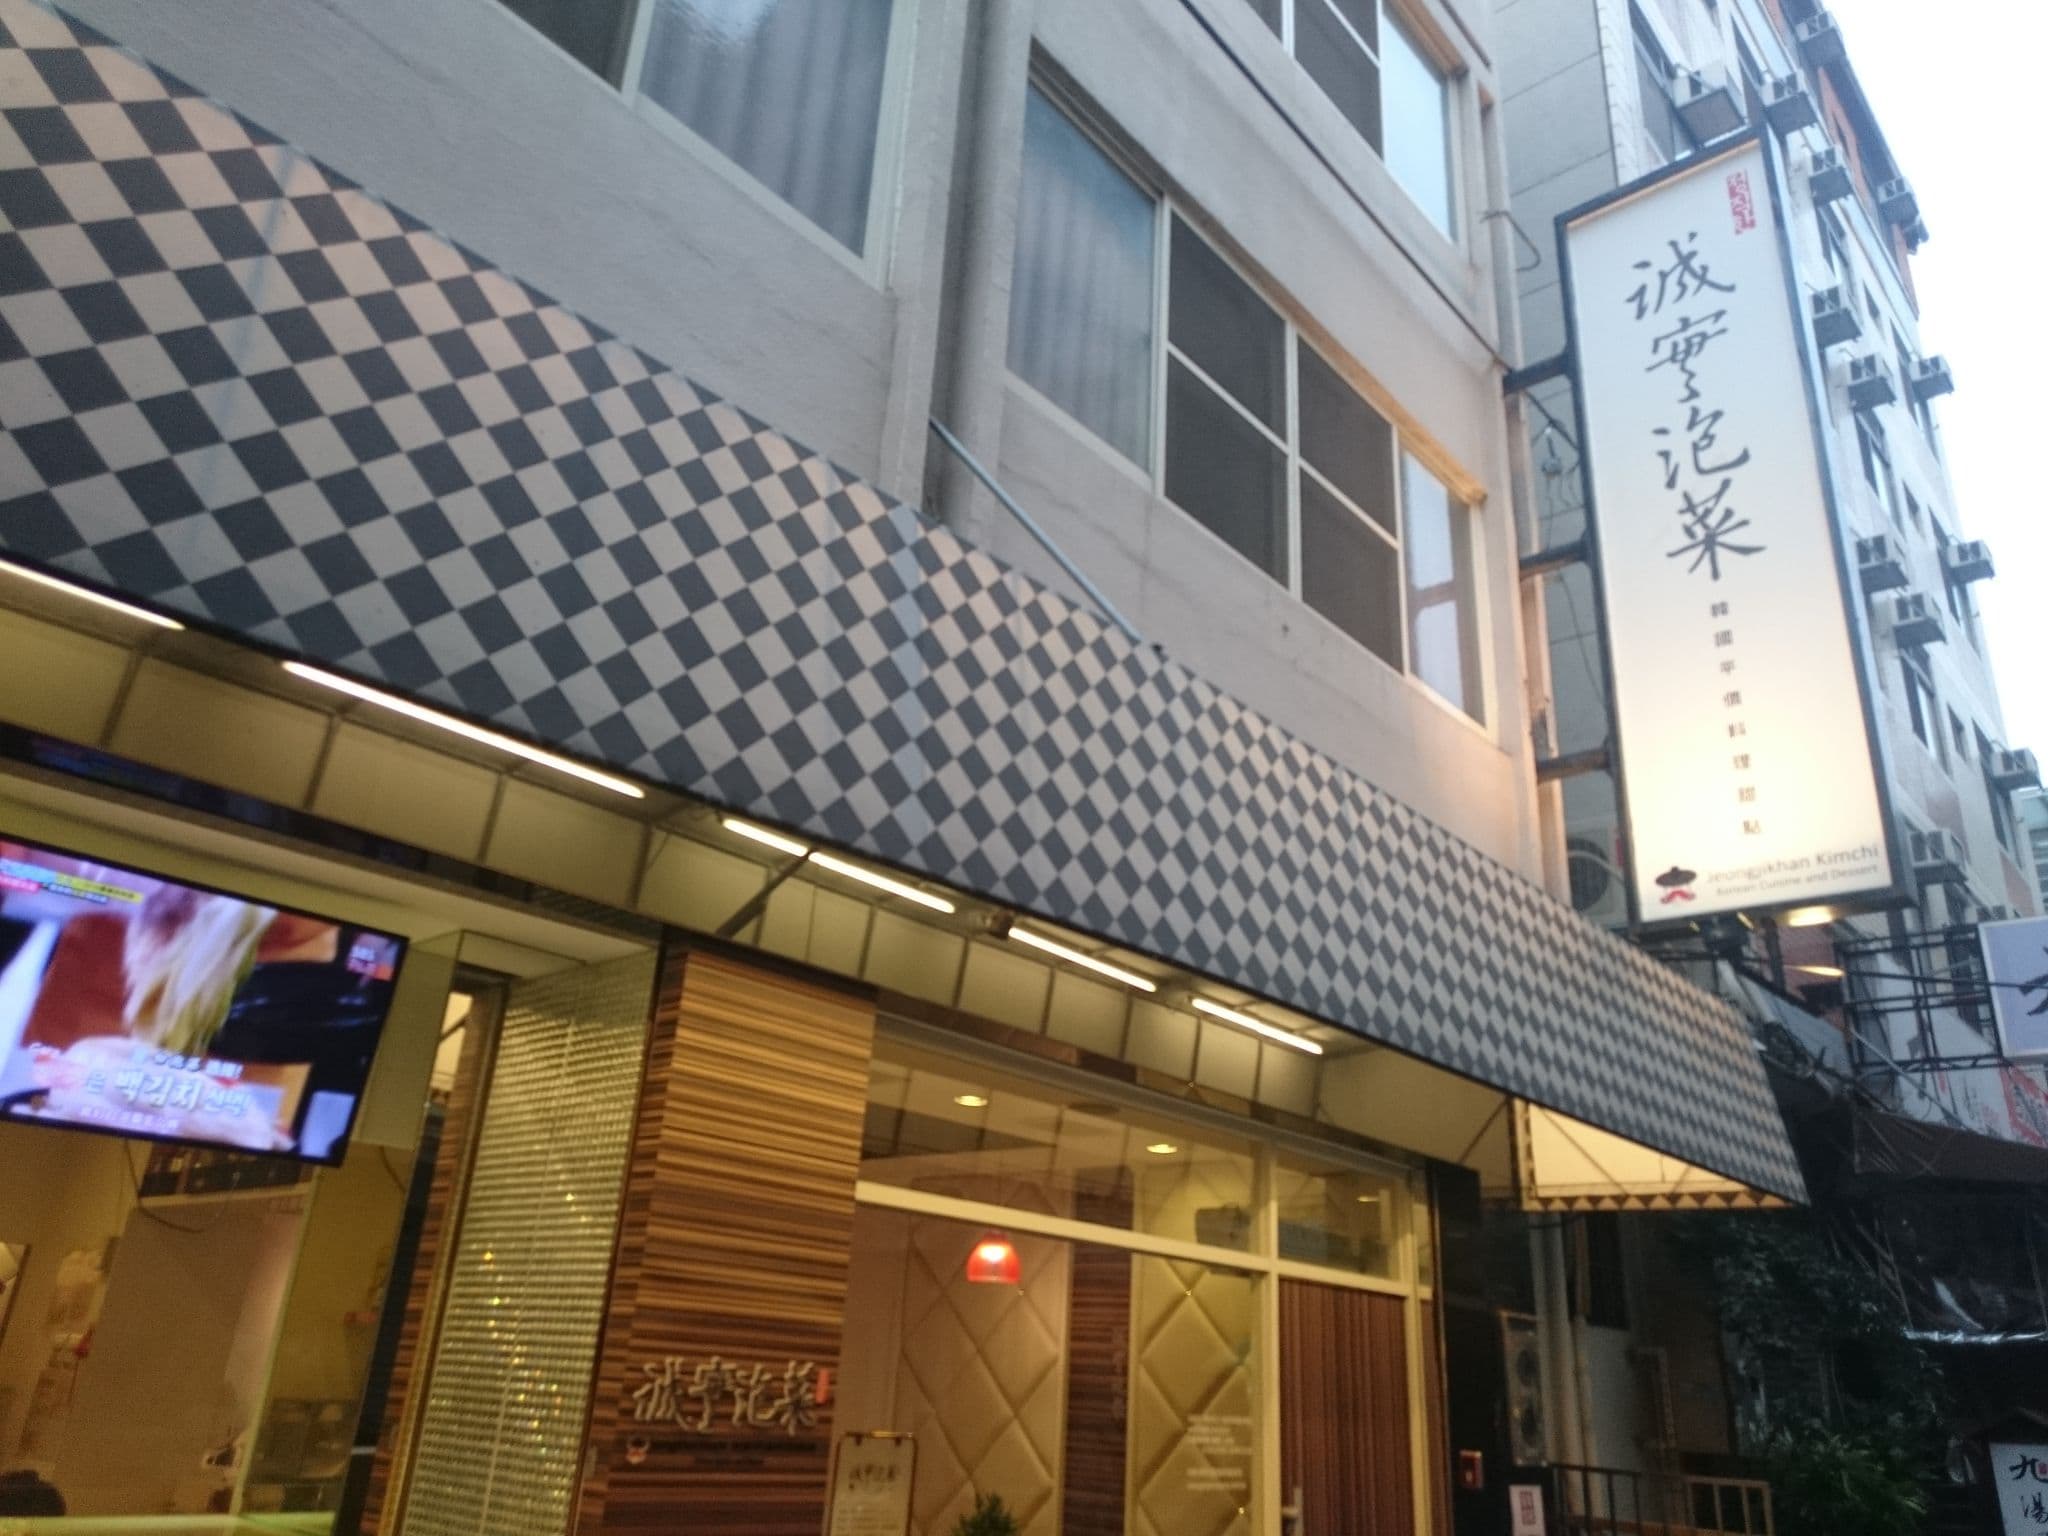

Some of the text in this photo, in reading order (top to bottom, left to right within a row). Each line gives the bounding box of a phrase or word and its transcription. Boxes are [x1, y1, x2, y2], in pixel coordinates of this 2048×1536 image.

[1625, 230, 1768, 581] 誠實泡菜
[1815, 843, 1880, 866] Kimchi
